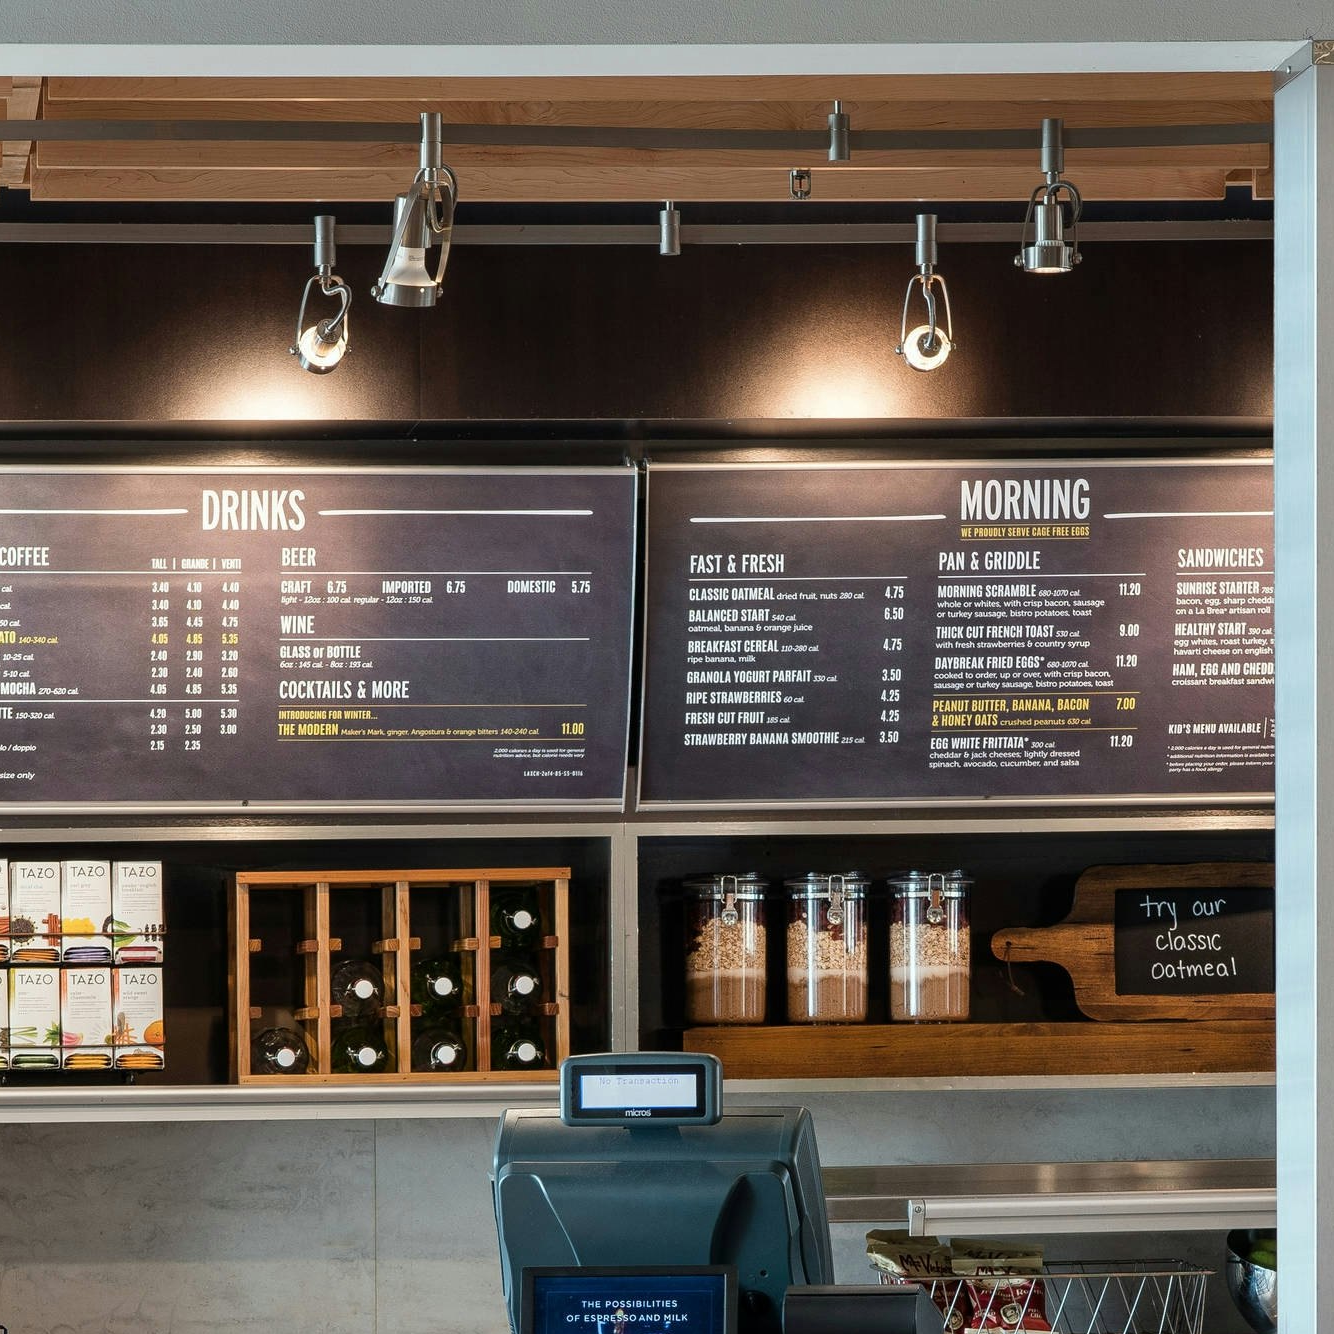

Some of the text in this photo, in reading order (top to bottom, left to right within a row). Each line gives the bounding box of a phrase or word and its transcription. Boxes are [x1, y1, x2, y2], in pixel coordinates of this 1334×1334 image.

[961, 479, 1089, 520] MORNING
[203, 489, 305, 531] DRINKS
[961, 527, 1089, 537] WE PROUDLY SERVE CAGE FREE EGGS
[0, 547, 49, 566] COFFEE
[282, 548, 316, 568] BEER
[939, 551, 1040, 570] PAN & GRIDDLE
[1178, 548, 1263, 567] SANDWICHES
[152, 558, 167, 569] TALL
[221, 559, 241, 569] VENTI
[691, 554, 784, 573] FAST & FRESH
[281, 581, 590, 593] CRAFT 6.75 IMPORTED 6.75 DOMESTIC 5.75
[689, 607, 904, 622] BALANCED START 6.50
[281, 616, 315, 633] WINE
[936, 624, 1139, 638] THICK CUT FRENCH TOAST 9.00
[152, 634, 168, 644] 4.05
[186, 634, 202, 644] 4.85
[222, 634, 238, 644] 5.35
[280, 646, 360, 658] GLASS or BOTTLE
[1, 682, 36, 695] MOCHA
[280, 681, 409, 699] COCKTAILS & MORE
[278, 723, 584, 735] THE MODERN 11.00
[20, 868, 55, 878] TAZO
[71, 866, 105, 877] TAZO
[122, 867, 156, 877] TAZO
[1140, 896, 1226, 931] try our
[1156, 932, 1221, 950] classic
[1152, 957, 1236, 979] oatmeal
[19, 974, 53, 984] TAZO
[70, 974, 104, 984] TAZO
[123, 974, 158, 984] TAZO
[600, 1077, 679, 1085] No Transaction
[626, 1108, 650, 1116] micros
[606, 1300, 677, 1308] POSSIBILITIES
[664, 1314, 688, 1322] MILK
